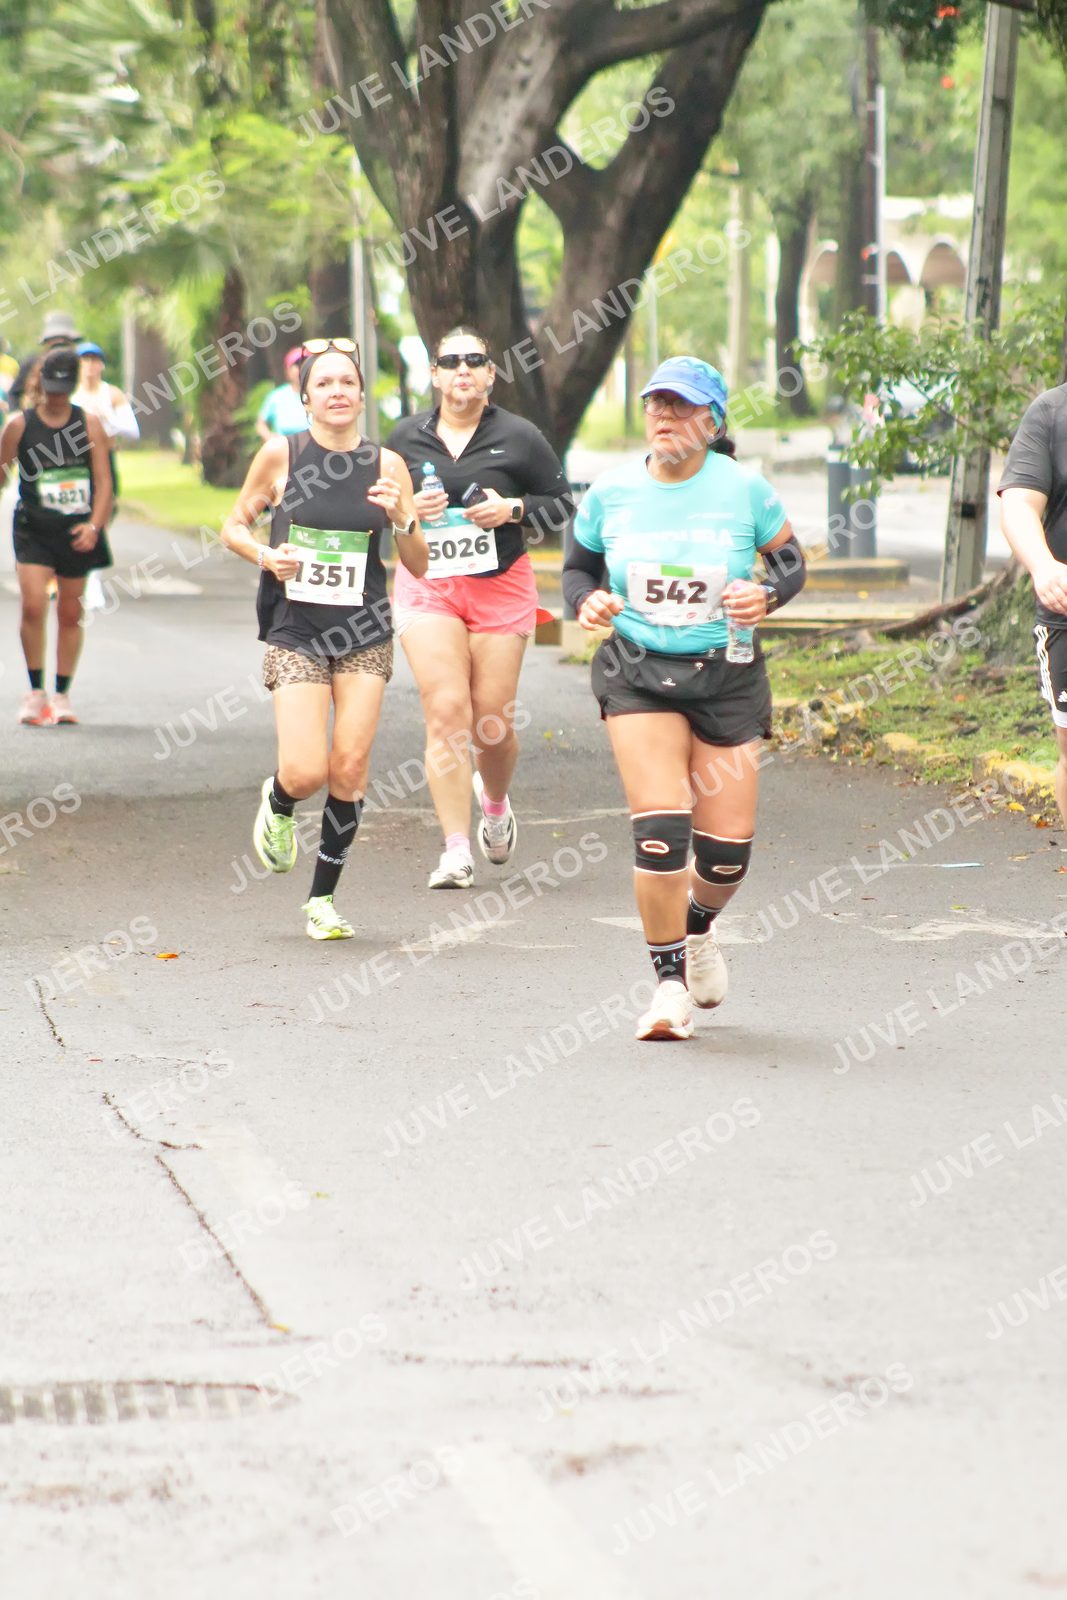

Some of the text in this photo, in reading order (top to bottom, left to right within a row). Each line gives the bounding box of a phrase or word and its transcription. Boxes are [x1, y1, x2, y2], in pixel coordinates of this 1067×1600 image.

[428, 535, 490, 561] 5026
[295, 560, 356, 588] 1351
[645, 579, 708, 605] 542
